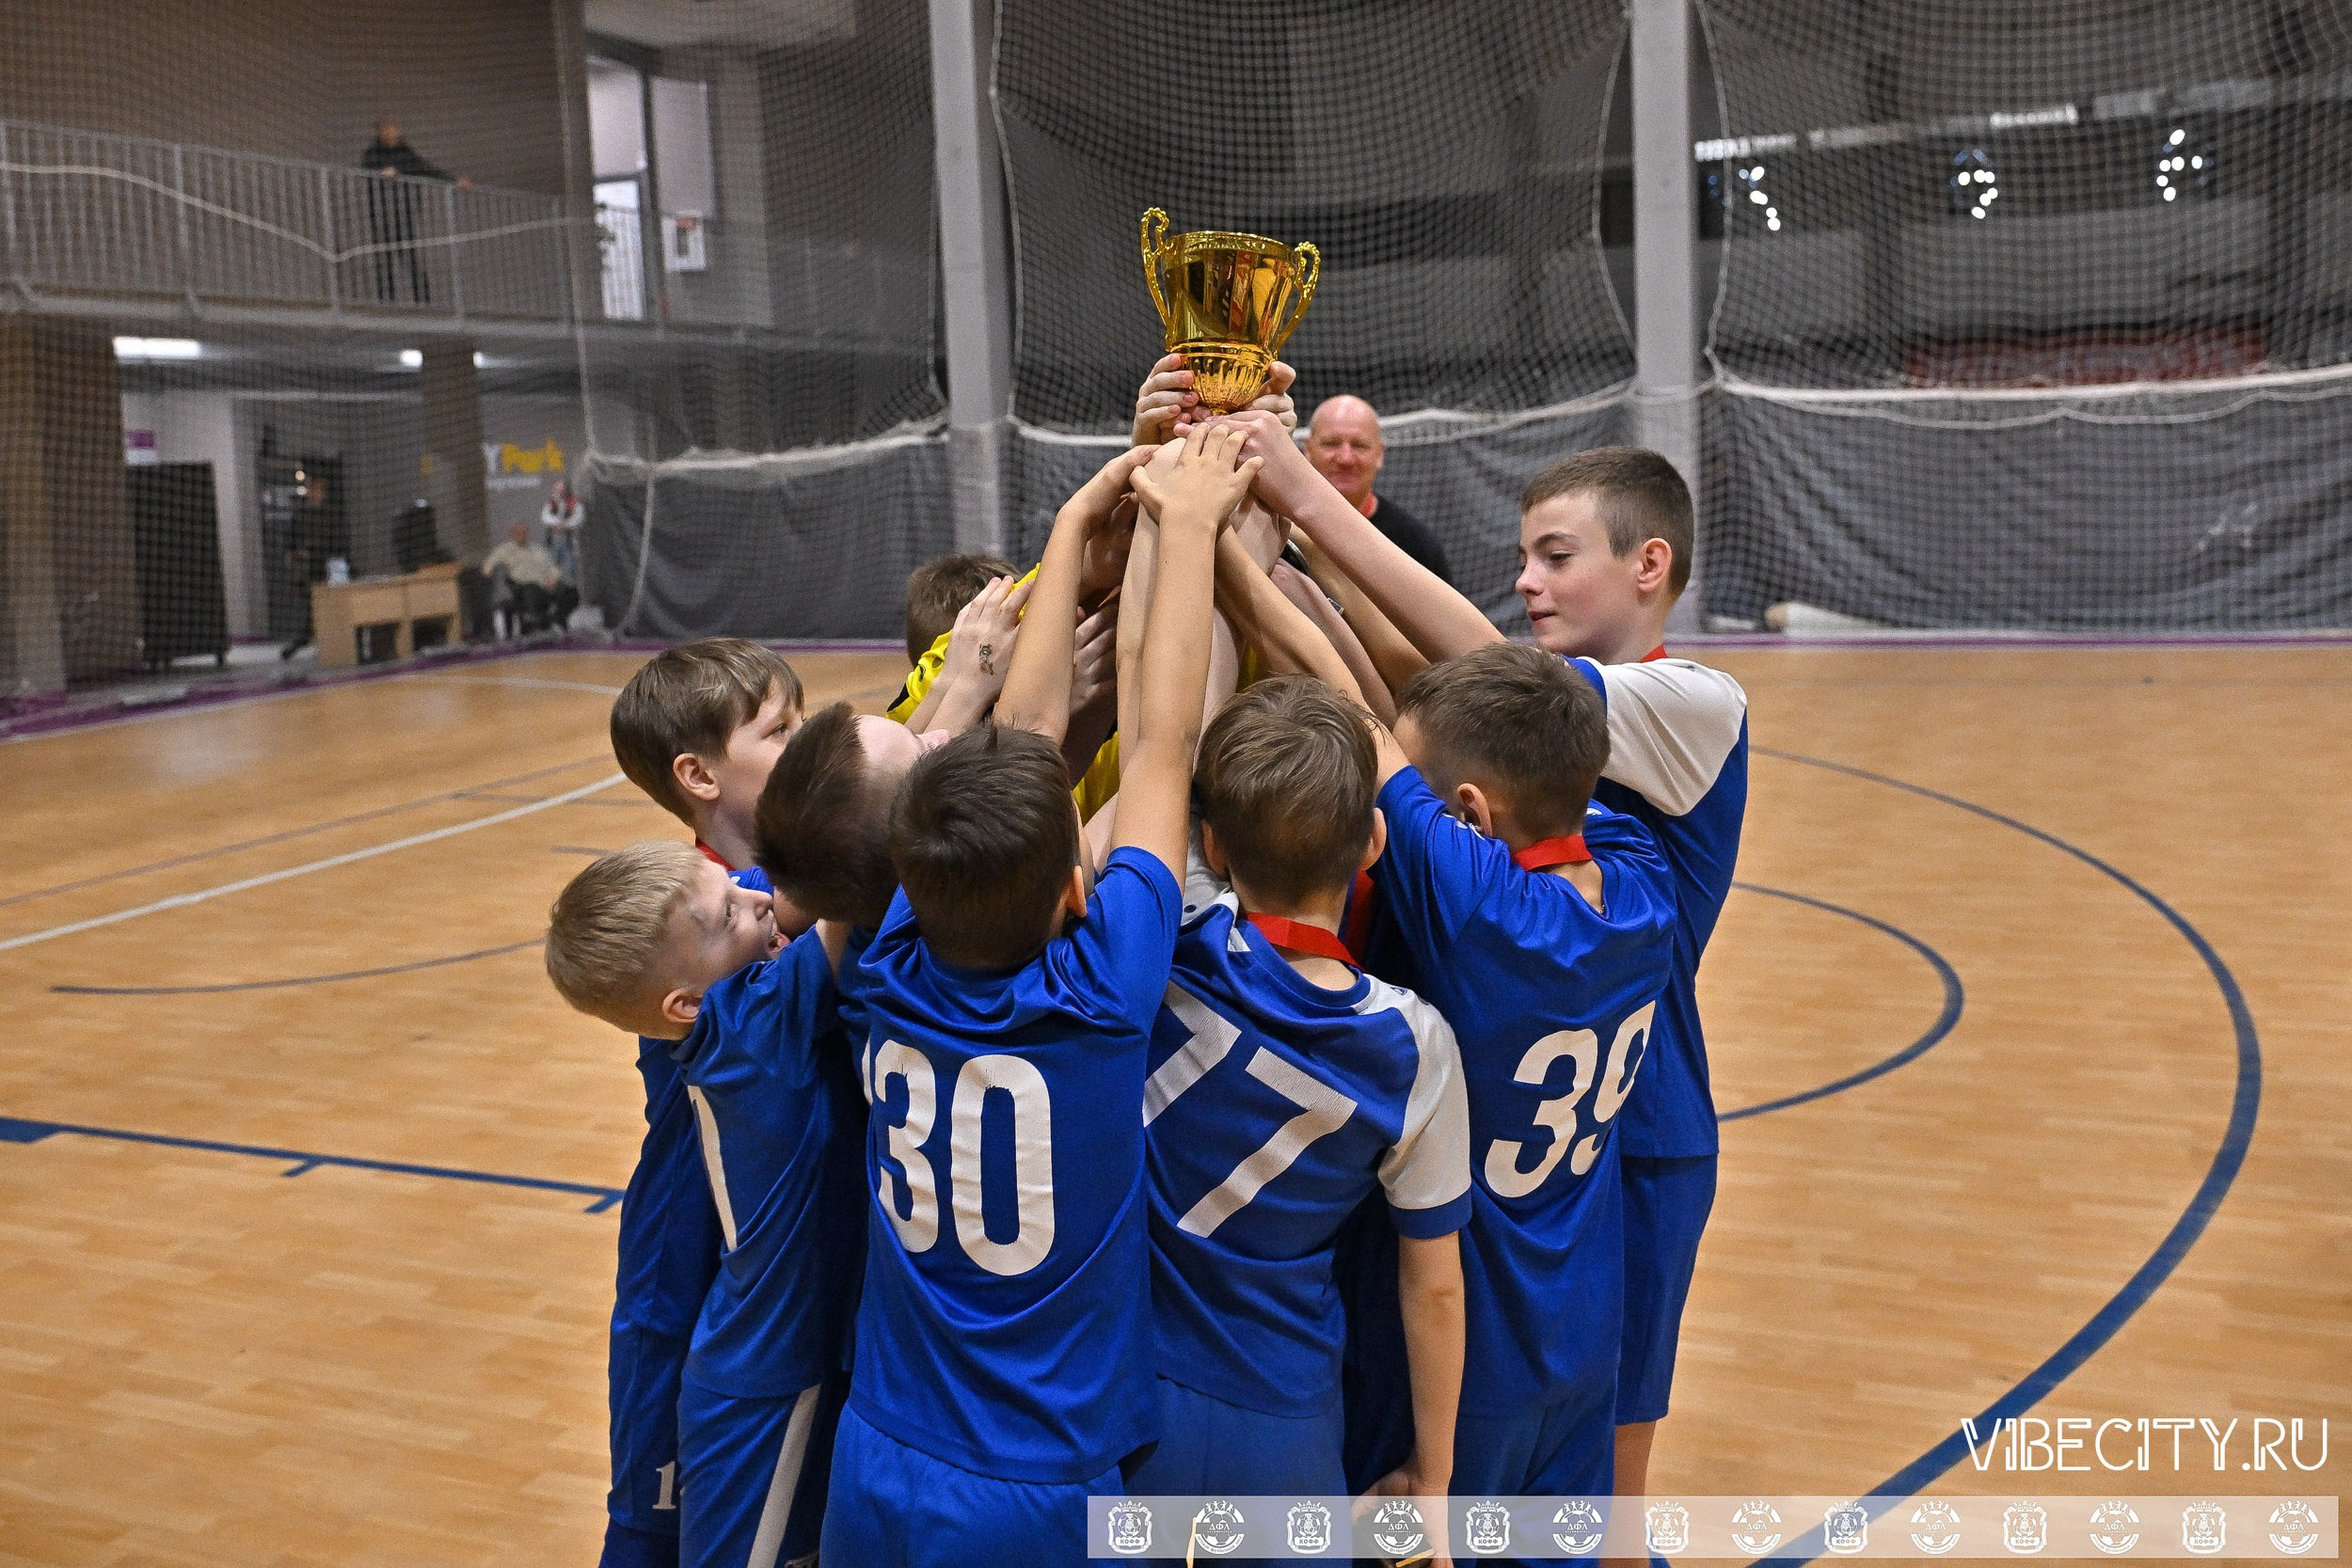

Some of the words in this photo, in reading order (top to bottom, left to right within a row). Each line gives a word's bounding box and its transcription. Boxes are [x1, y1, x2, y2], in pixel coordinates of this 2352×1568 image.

[874, 1039, 1056, 1275] 30
[1485, 1000, 1656, 1197] 39
[653, 1461, 685, 1510] 1
